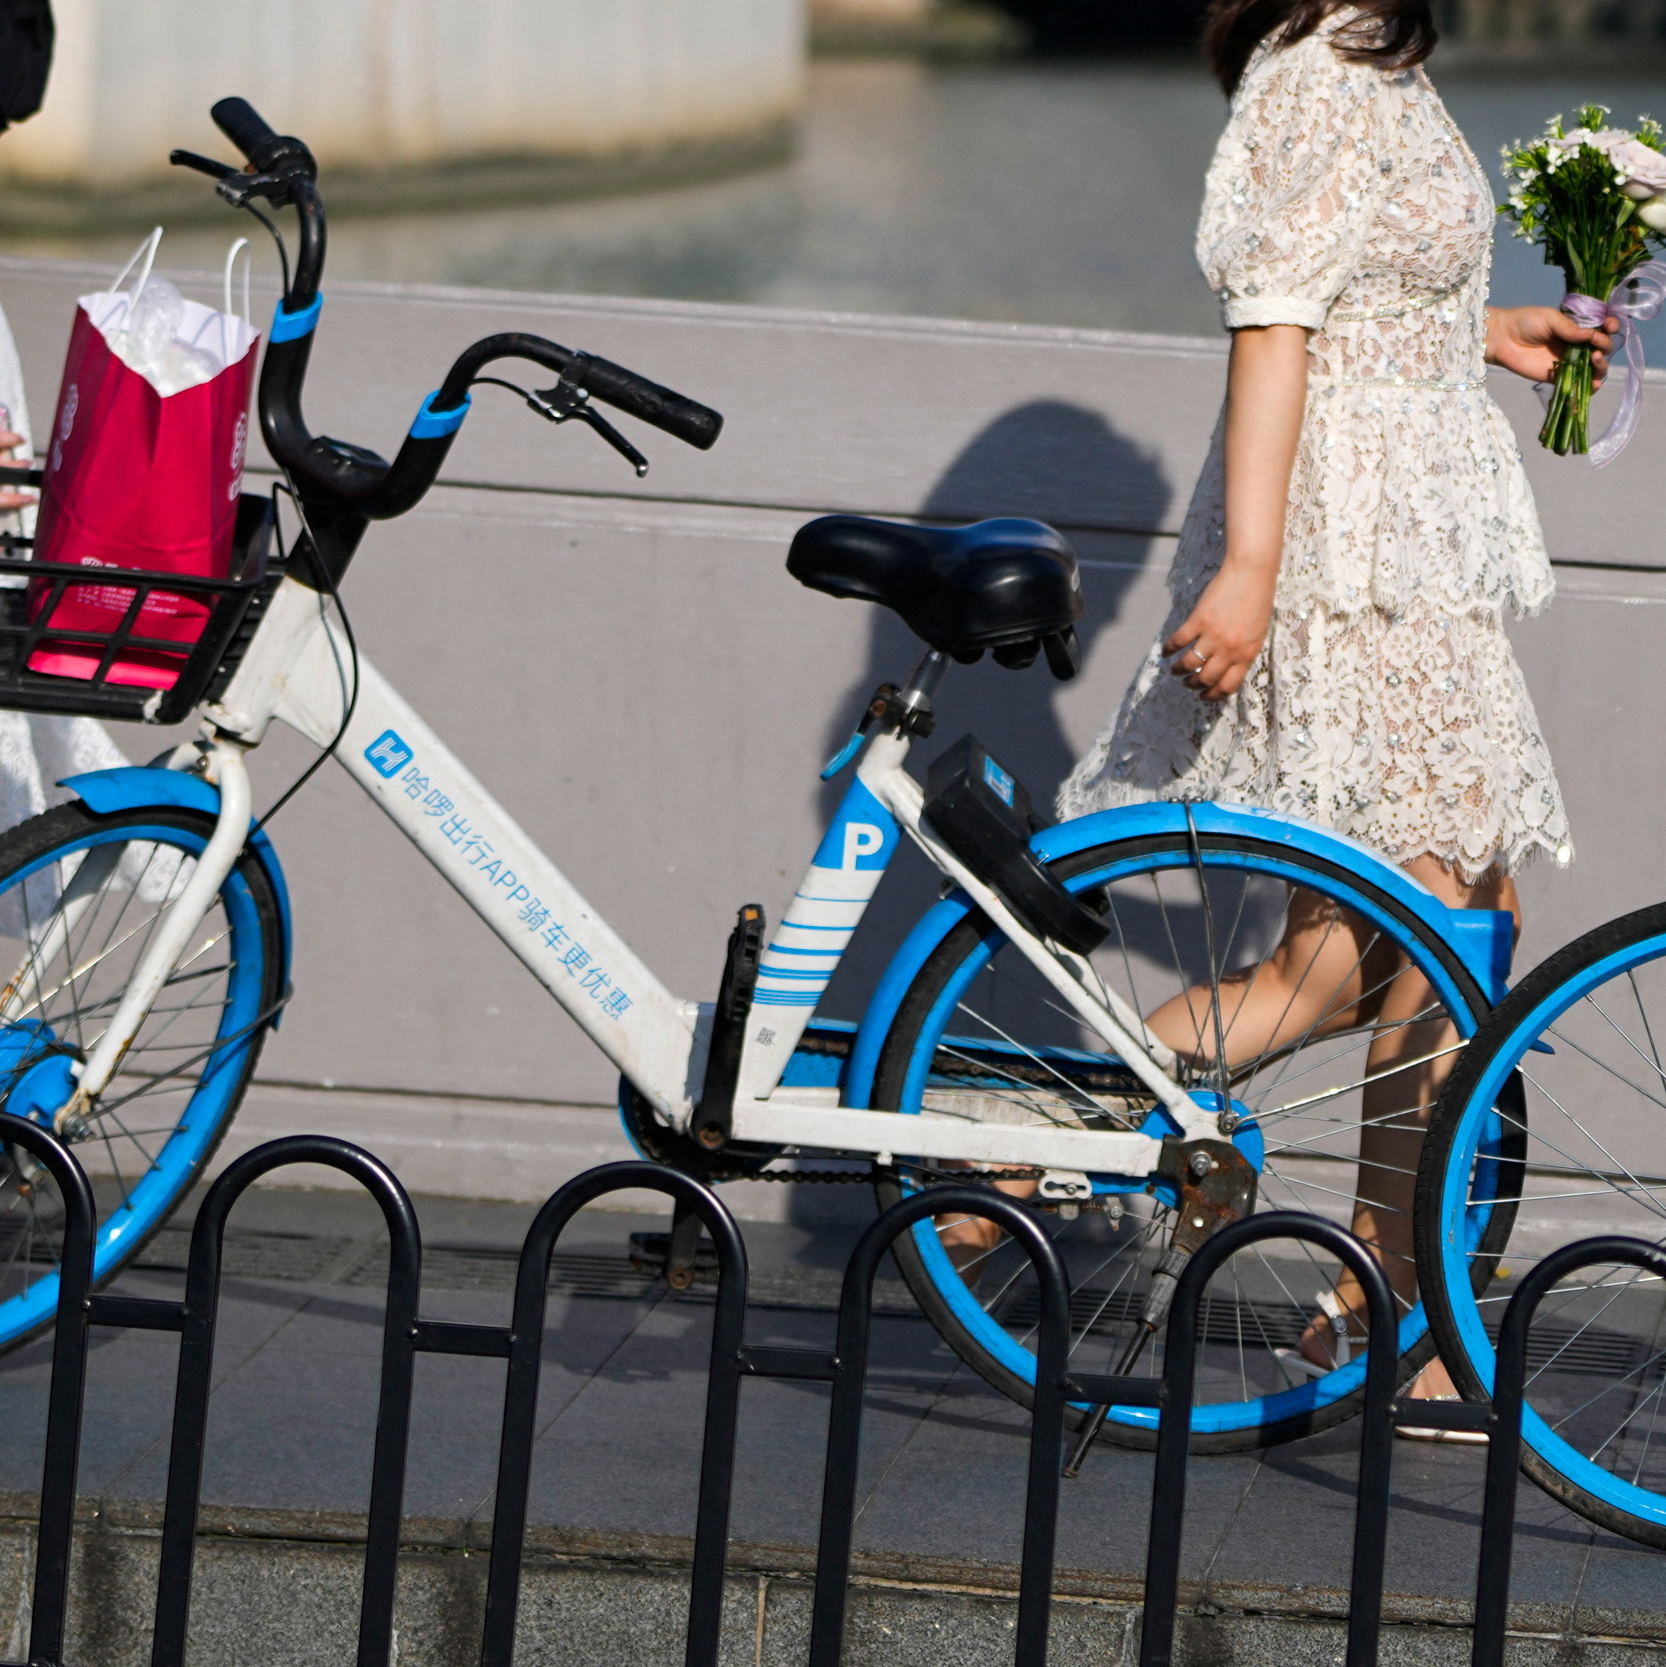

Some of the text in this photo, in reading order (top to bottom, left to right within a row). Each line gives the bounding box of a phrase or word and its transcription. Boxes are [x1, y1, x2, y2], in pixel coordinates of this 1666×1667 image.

[400, 768, 634, 1020] 哈啰出行APP骑车更优惠
[842, 822, 884, 870] P
